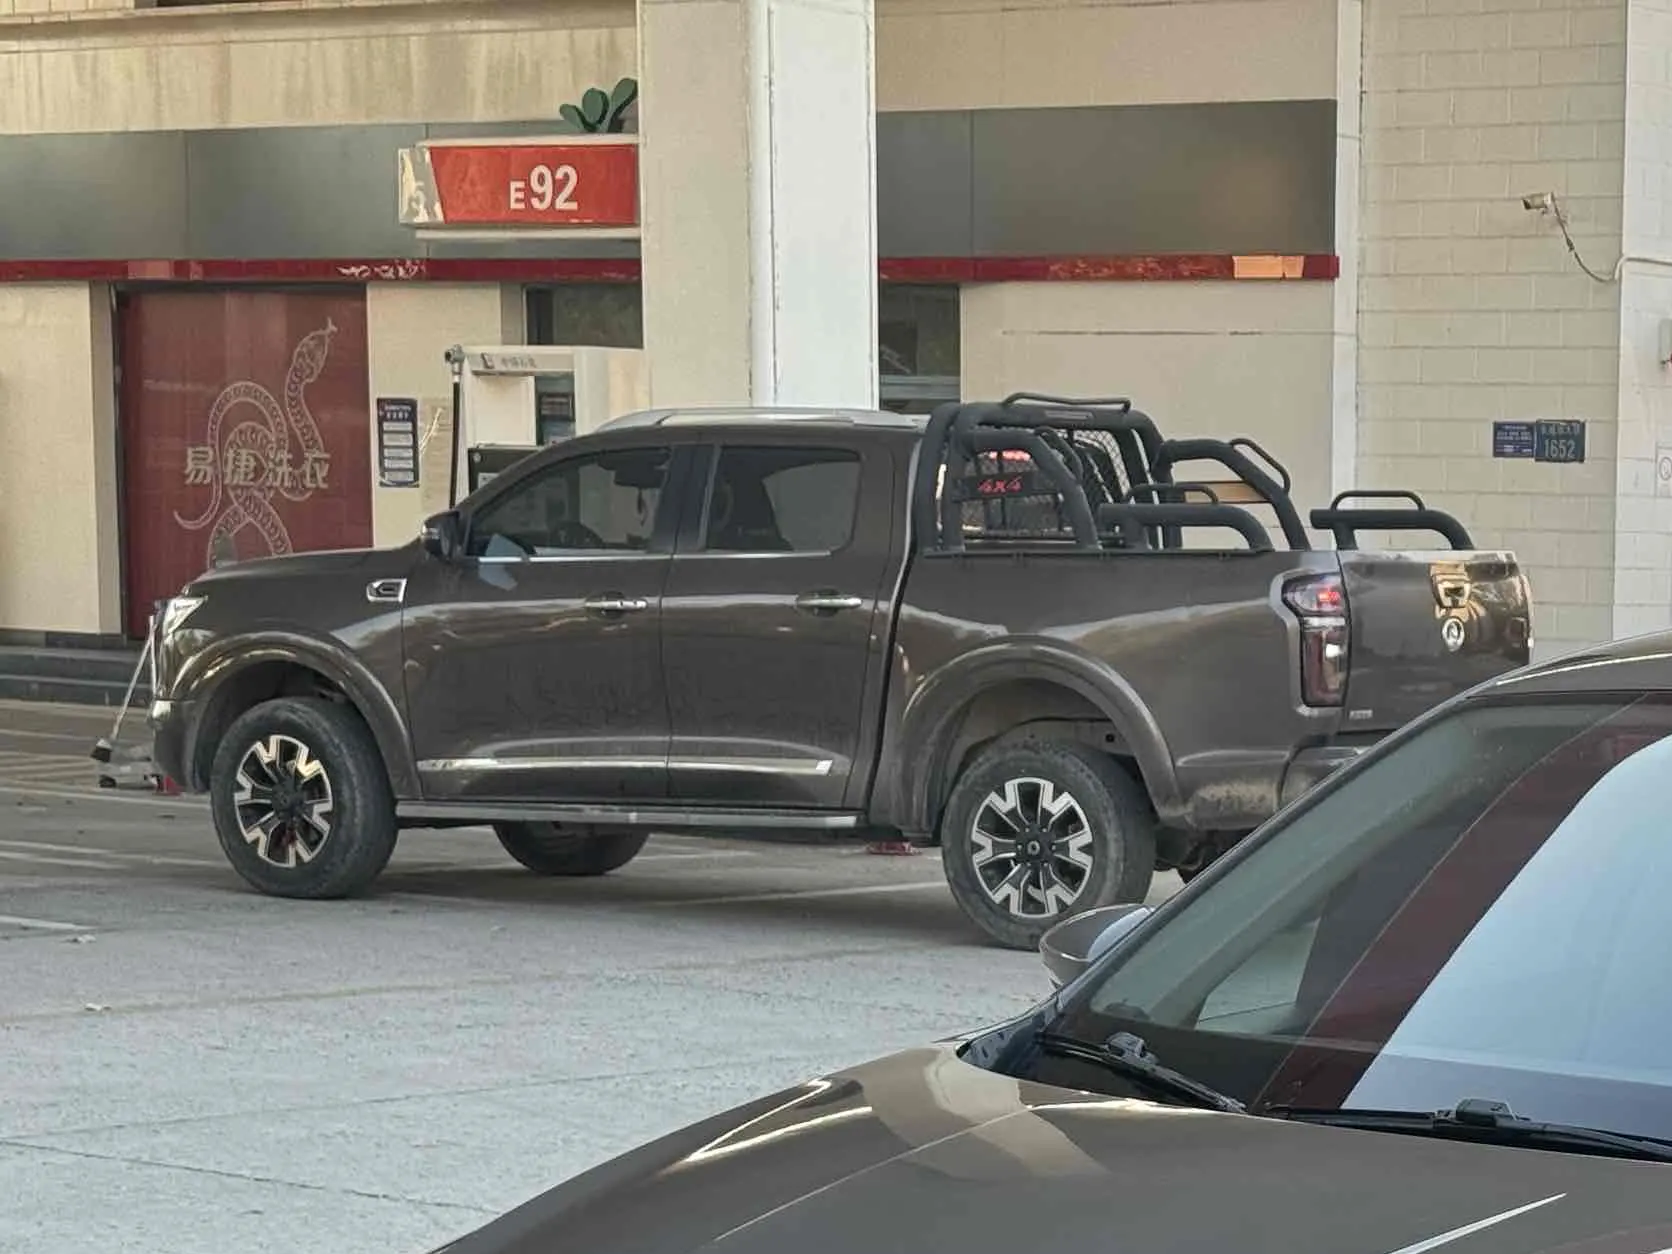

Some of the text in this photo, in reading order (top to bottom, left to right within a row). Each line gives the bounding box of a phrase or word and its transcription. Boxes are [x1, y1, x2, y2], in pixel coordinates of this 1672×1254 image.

[509, 164, 579, 212] E92
[184, 445, 331, 489] 易捷洗衣
[1544, 439, 1576, 459] 1652
